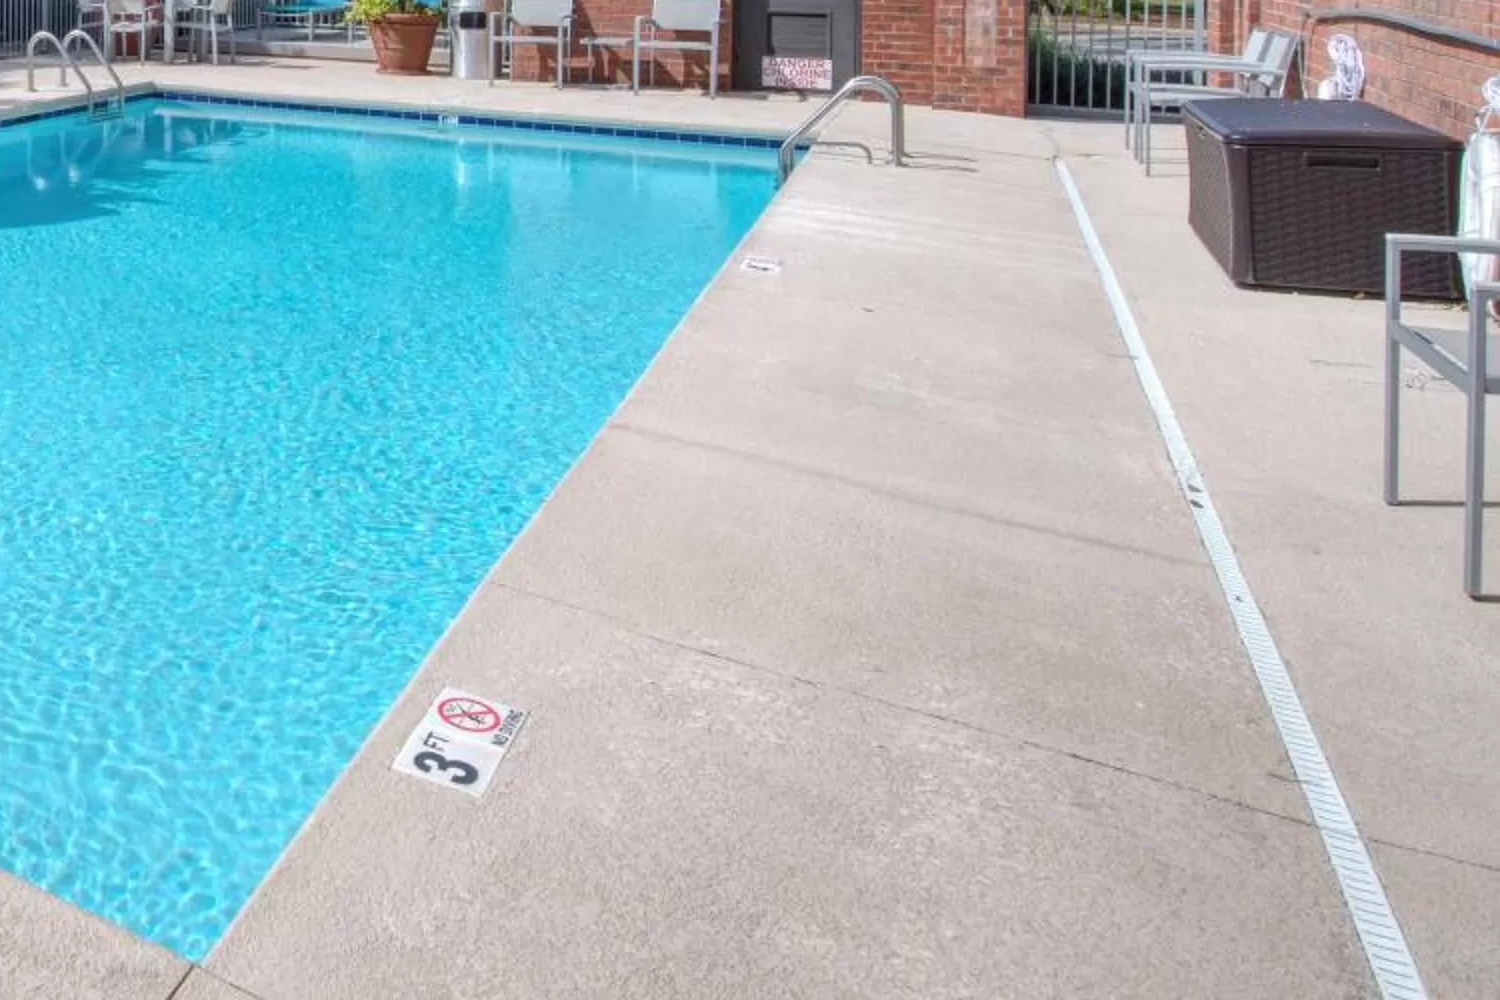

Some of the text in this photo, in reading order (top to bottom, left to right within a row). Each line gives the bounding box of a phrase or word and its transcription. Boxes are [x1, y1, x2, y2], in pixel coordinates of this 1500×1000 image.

[769, 58, 825, 69] DANGER
[413, 731, 479, 786] 3 FT
